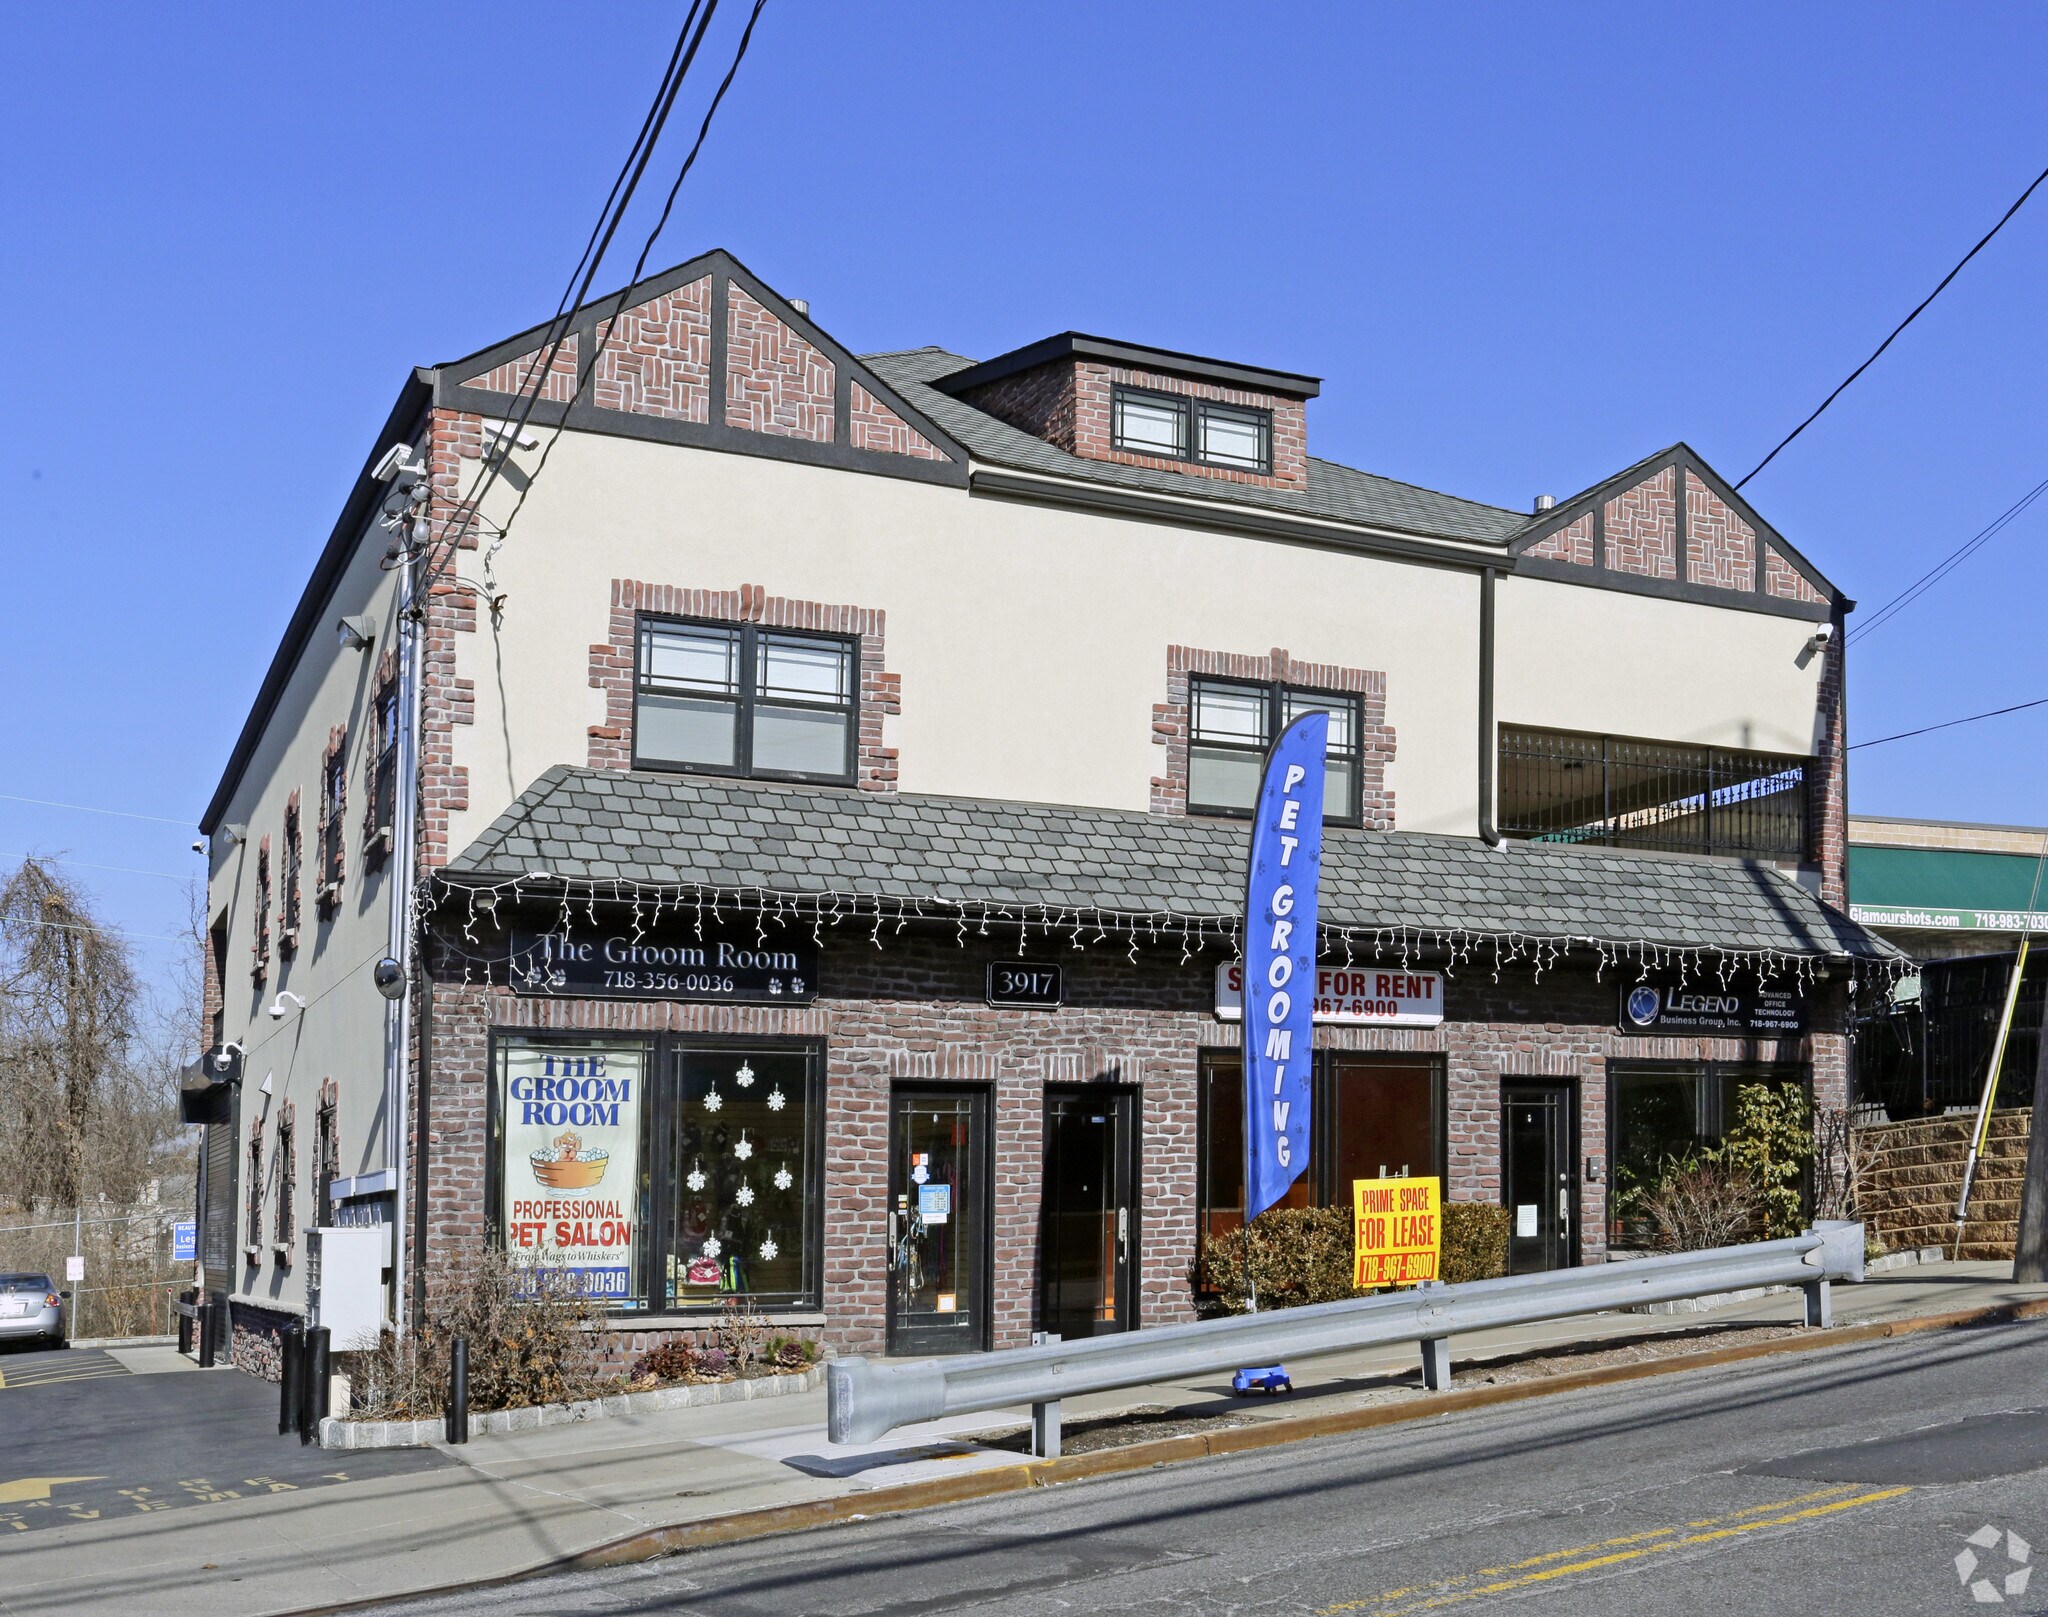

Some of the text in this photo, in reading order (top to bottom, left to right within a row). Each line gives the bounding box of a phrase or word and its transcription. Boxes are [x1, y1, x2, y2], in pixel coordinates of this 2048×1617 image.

[1849, 906, 2048, 930] Glamourshots.com 718-983-7030
[536, 932, 799, 970] The Groom Room
[1265, 764, 1305, 1168] PET GROOMING
[604, 970, 734, 992] 718-356-0036
[999, 971, 1055, 995] 3917
[1318, 971, 1436, 999] FOR RENT
[1665, 986, 1739, 1014] LEGEND
[1759, 991, 1792, 999] ADVANCED
[1764, 1000, 1787, 1008] OFFICE
[1660, 1015, 1697, 1025] Business
[1727, 1018, 1742, 1027] Inc.
[1750, 1019, 1799, 1029] 718-967-6900
[1754, 1008, 1796, 1017] TECHNOLOGY
[540, 1053, 607, 1077] THE
[510, 1077, 632, 1102] GROOM
[521, 1102, 620, 1126] ROOM
[513, 1200, 623, 1219] PROFESSIONAL
[1362, 1187, 1429, 1214] PRIME SPACE
[555, 1221, 631, 1247] SALON
[1359, 1215, 1434, 1250] FOR LEASE
[568, 1252, 577, 1261] to
[1361, 1253, 1434, 1283] 718-967-6900
